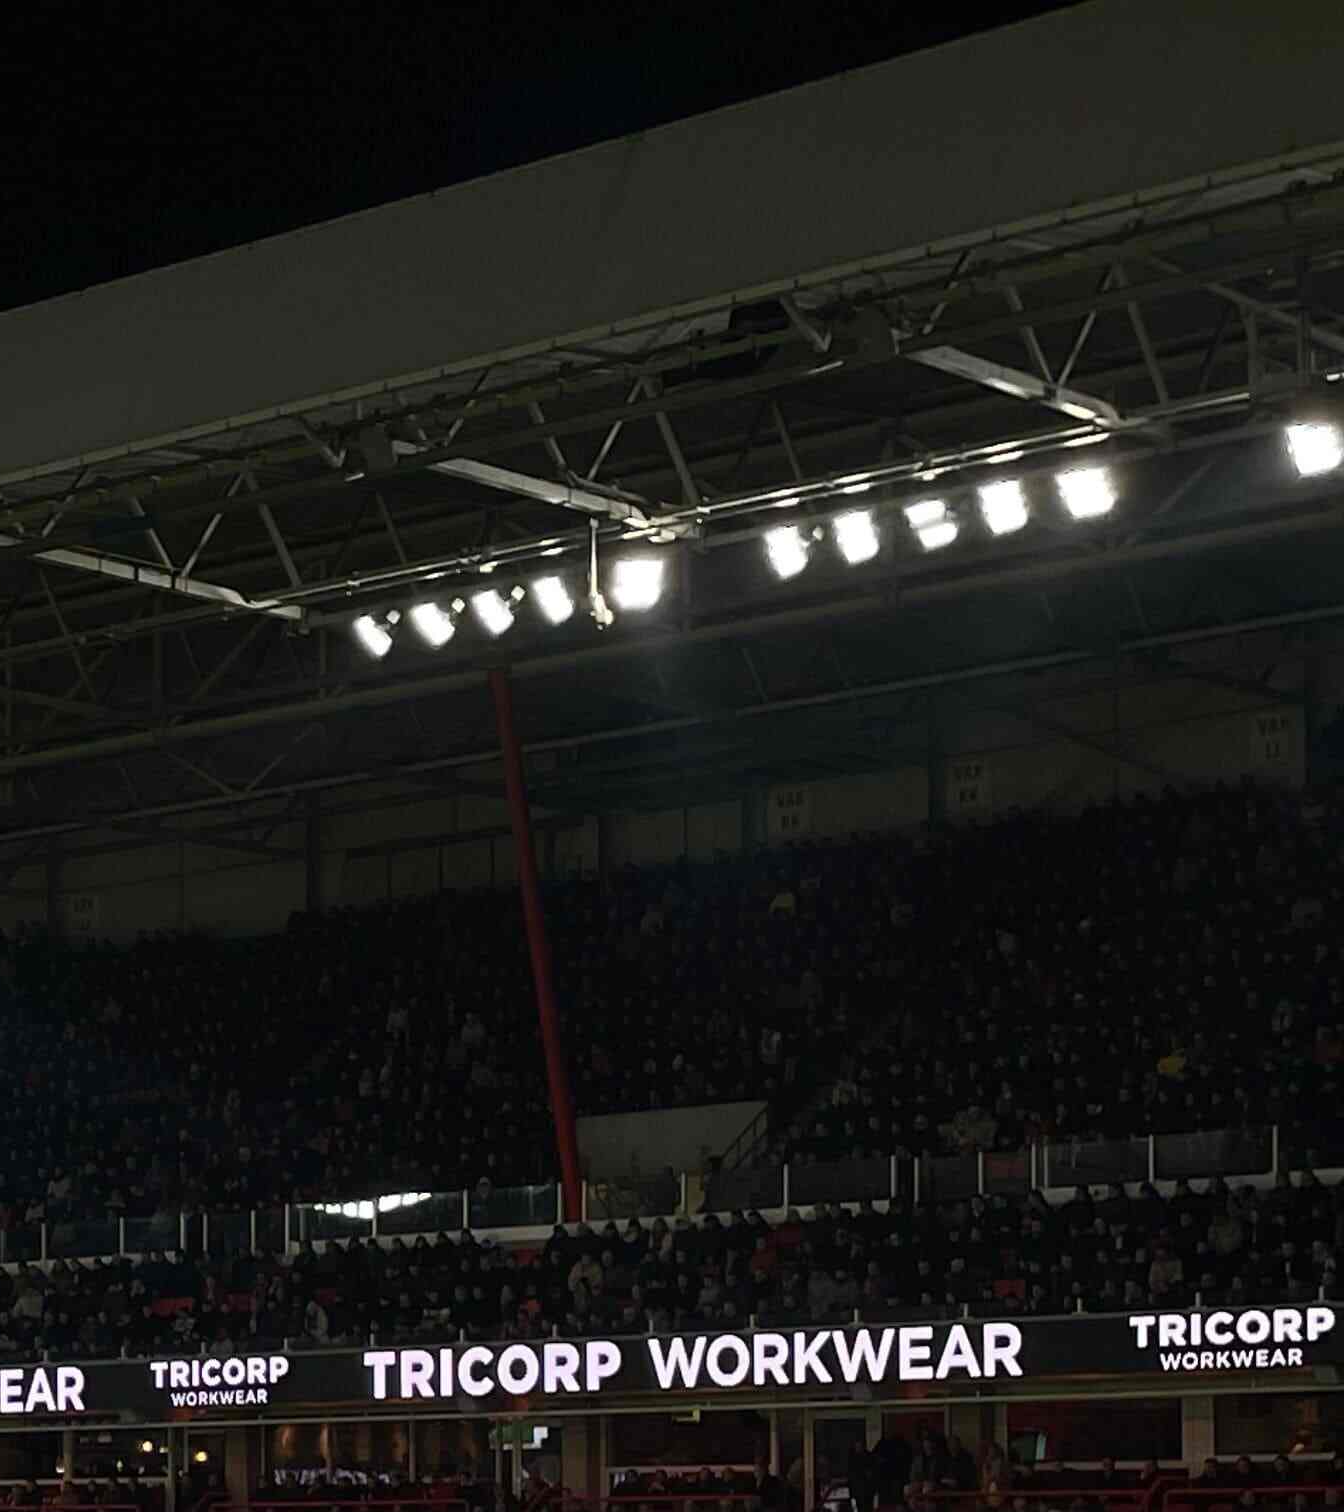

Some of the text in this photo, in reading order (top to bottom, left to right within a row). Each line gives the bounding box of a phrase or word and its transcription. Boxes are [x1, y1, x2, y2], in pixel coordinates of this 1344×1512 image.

[1129, 1307, 1336, 1349] TRICORP
[149, 1356, 289, 1388] TRICORP
[363, 1322, 1023, 1400] TRICORP WORKWEAR
[1159, 1348, 1303, 1371] WORKWEAR
[170, 1388, 268, 1407] WORKWEAR
